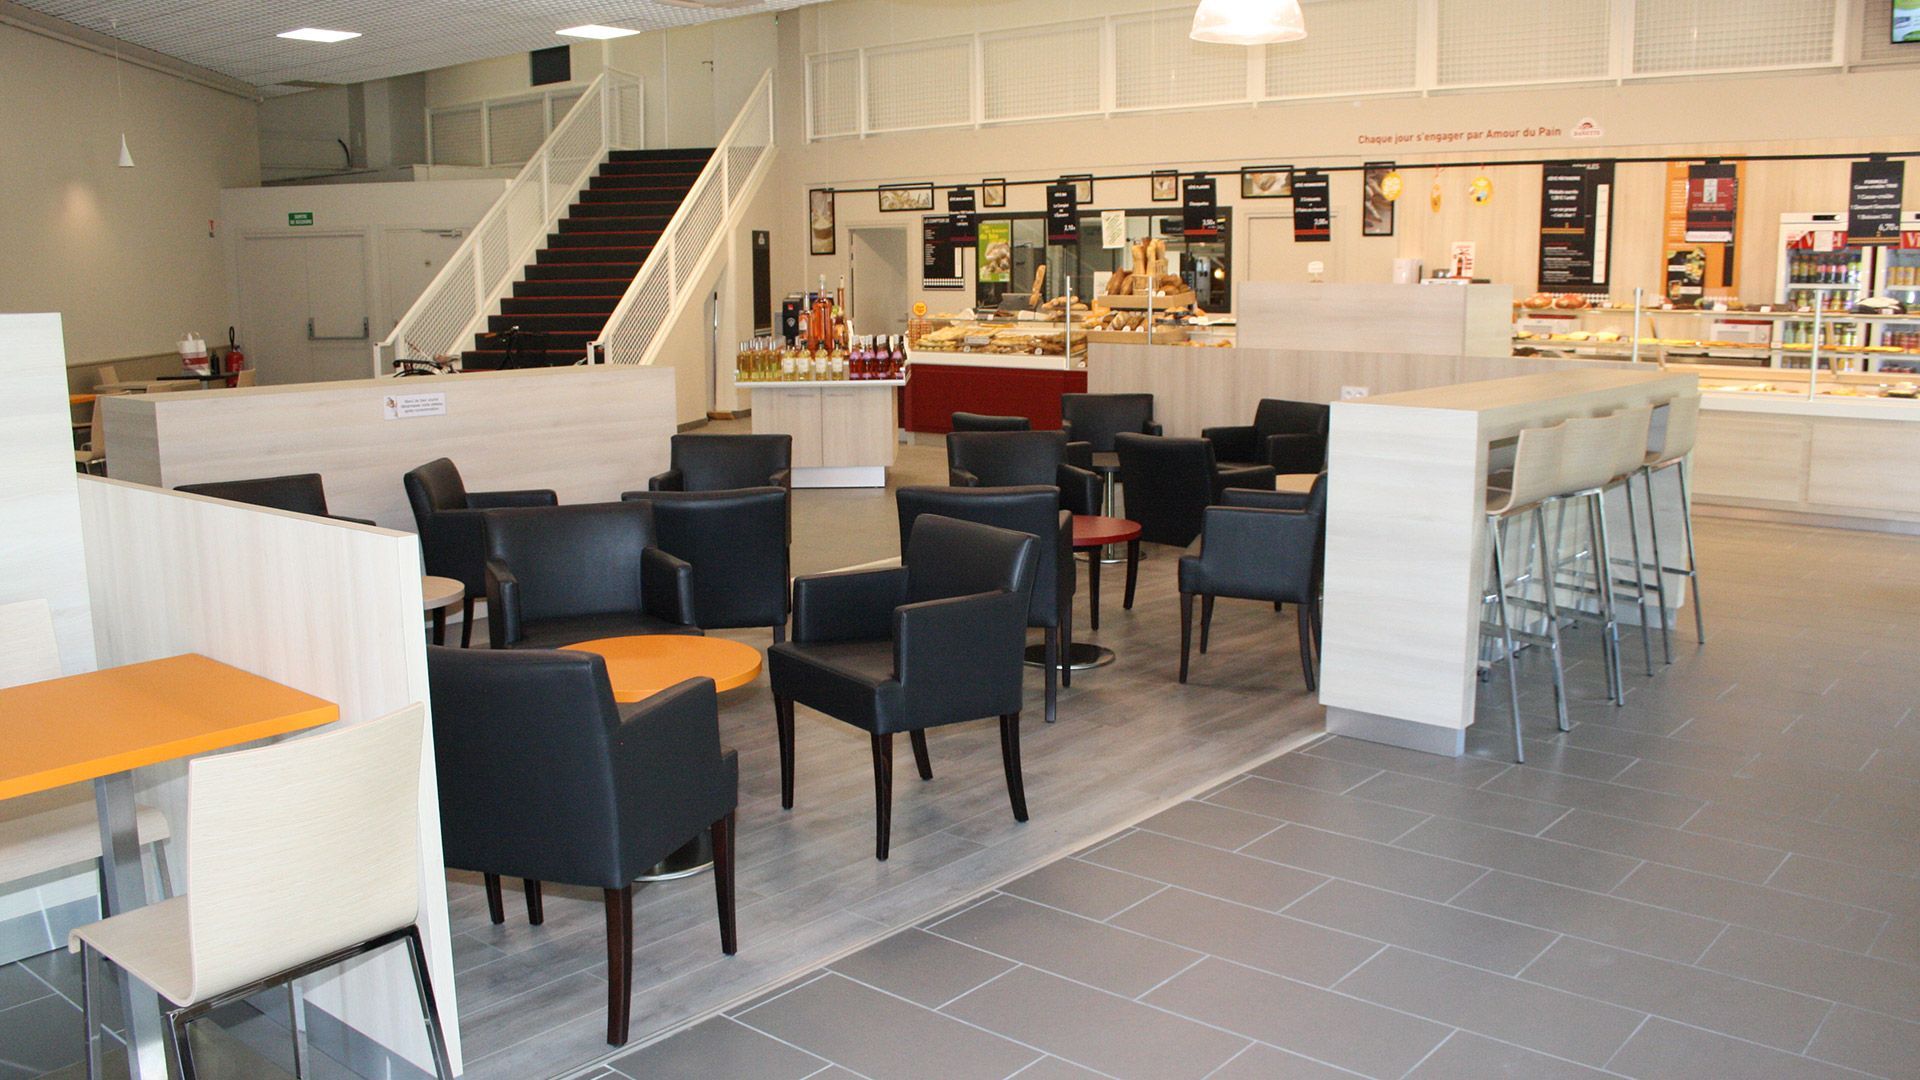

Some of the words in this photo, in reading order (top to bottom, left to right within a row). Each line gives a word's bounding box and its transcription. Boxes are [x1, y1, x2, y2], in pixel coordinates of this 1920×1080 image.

[1358, 135, 1393, 145] Chaque
[1394, 133, 1414, 144] jour
[1416, 131, 1464, 143] s'engager
[1466, 131, 1484, 141] par
[1486, 129, 1520, 138] Amour
[1522, 127, 1536, 137] du
[1538, 127, 1562, 137] Pain
